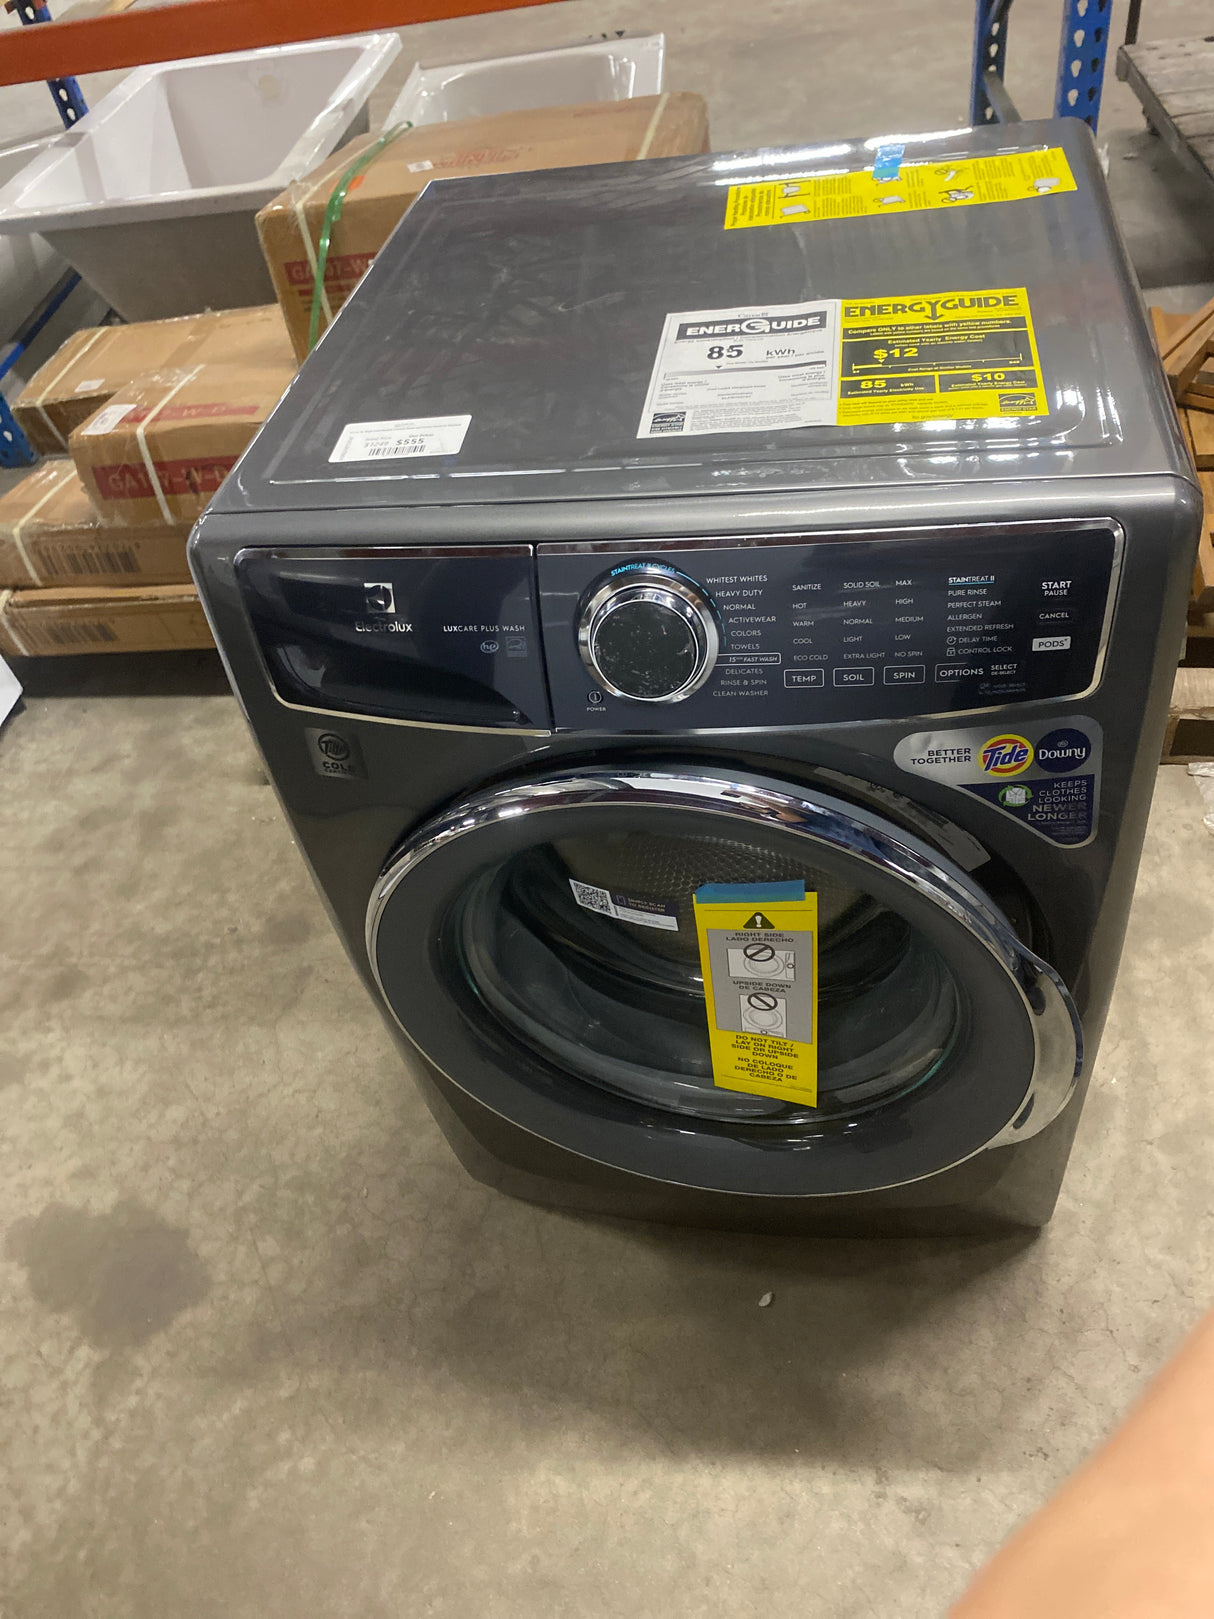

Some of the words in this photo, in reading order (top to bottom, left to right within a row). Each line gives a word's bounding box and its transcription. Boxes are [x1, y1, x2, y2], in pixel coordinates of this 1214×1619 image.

[845, 295, 1019, 321] ENERGYGUIDE
[707, 345, 743, 359] 85
[873, 348, 918, 359] $12
[972, 373, 1005, 382] $10
[861, 380, 886, 388] 85
[396, 438, 424, 446] $555
[611, 563, 645, 576] STAINTREAT
[706, 576, 738, 584] WHITEST
[739, 575, 768, 583] WHITES
[792, 583, 822, 591] SANITIZE
[1041, 581, 1072, 589] START
[743, 589, 763, 597] DUTY
[844, 600, 866, 608] HEAVY
[1039, 612, 1069, 620] CANCEL
[355, 621, 413, 632] Electrolux
[947, 624, 983, 632] EXTENDED
[984, 623, 1014, 631] REFRESH
[731, 629, 761, 637] COLORS
[793, 637, 812, 645] COOL
[959, 636, 981, 644] DELAY
[958, 647, 991, 655] CONTROL
[793, 654, 808, 662] ECO
[991, 663, 1017, 671] SELECT
[893, 671, 916, 679] SPIN
[939, 668, 984, 677] OPTIONS
[751, 678, 767, 686] SPIN
[792, 675, 817, 683] TEMP
[713, 689, 737, 697] CLEAN
[739, 689, 768, 697] WASHER
[928, 748, 971, 757] BETTER
[1039, 747, 1086, 760] Downy
[911, 755, 972, 765] TOGETHER
[983, 744, 1029, 771] Tide
[1054, 779, 1087, 788] KEEPS
[1039, 787, 1087, 797] CLOTHES
[1038, 794, 1086, 803] LOOKING
[1032, 802, 1087, 812] NEWER
[1027, 811, 1087, 821] LONGER
[768, 1044, 794, 1053] RIGHT
[768, 1049, 799, 1058] UPSIDE
[753, 1059, 793, 1070] COLOQUE
[762, 1065, 784, 1073] LADO
[735, 1066, 775, 1077] DERECHO
[750, 1073, 783, 1082] CABEZA
